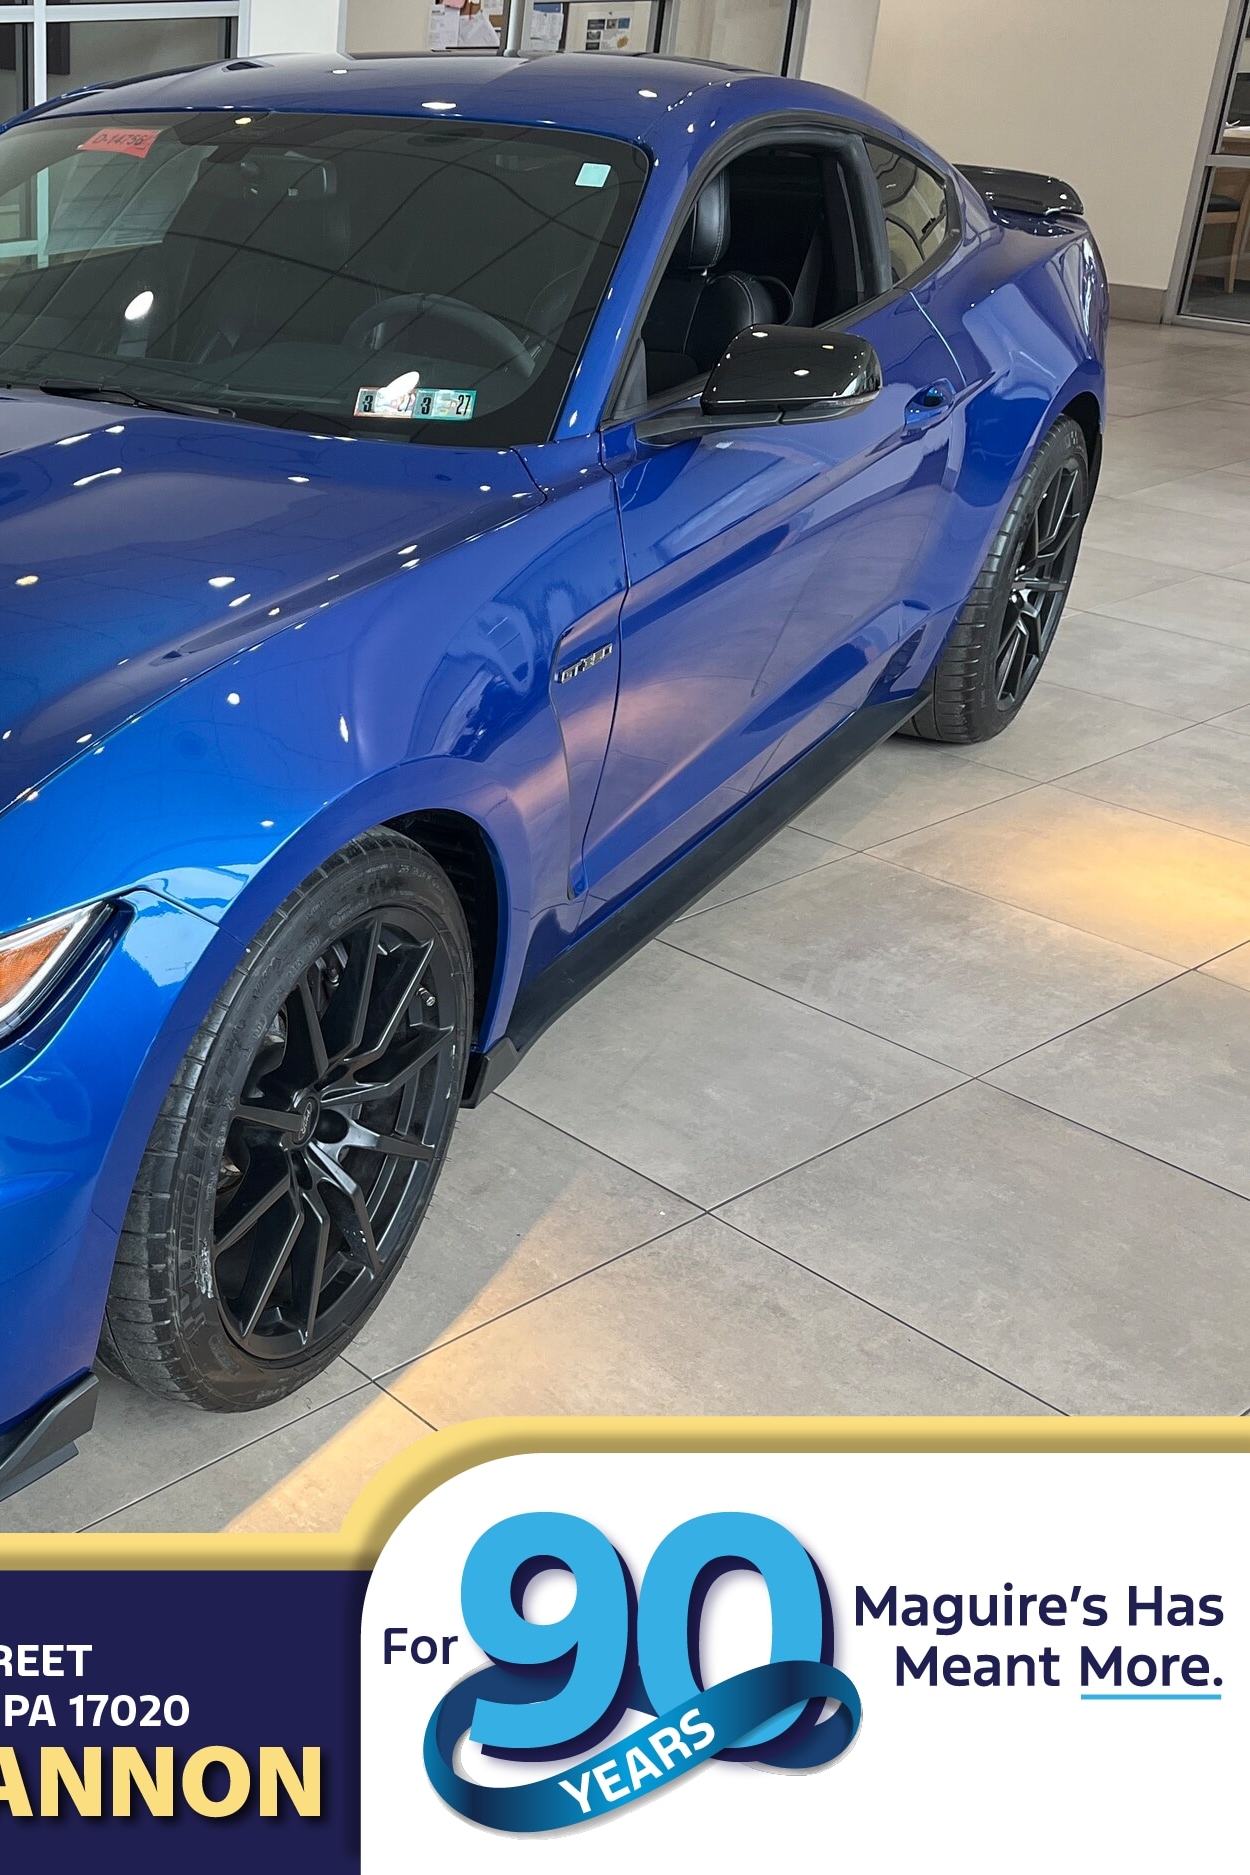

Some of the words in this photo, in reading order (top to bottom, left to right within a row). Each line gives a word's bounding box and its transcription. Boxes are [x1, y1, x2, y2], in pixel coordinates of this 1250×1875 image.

[362, 395, 373, 412] 3
[421, 397, 431, 415] 3
[455, 395, 471, 416] 27
